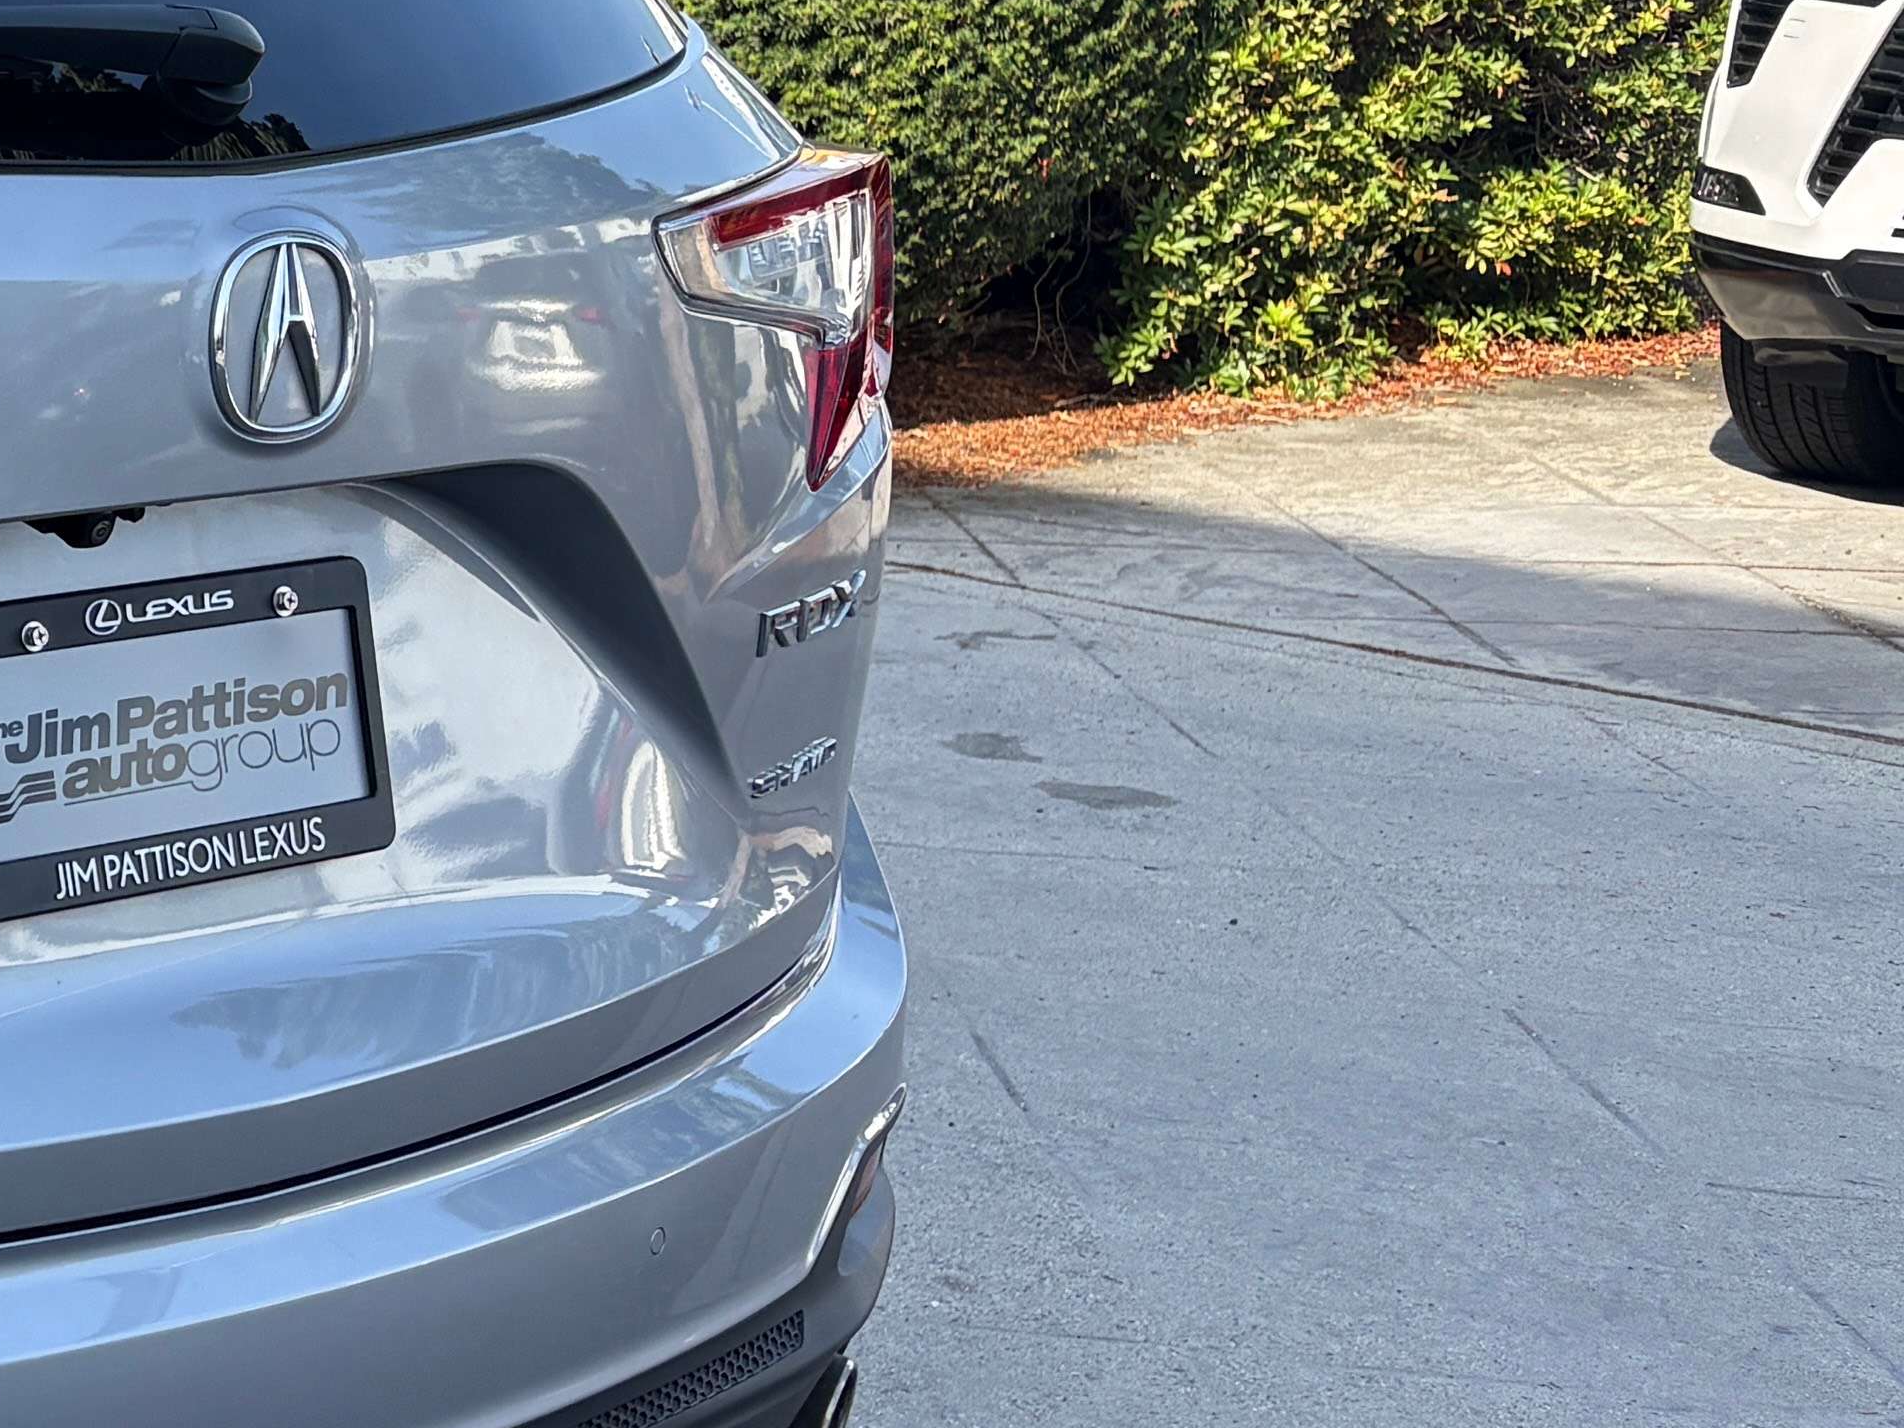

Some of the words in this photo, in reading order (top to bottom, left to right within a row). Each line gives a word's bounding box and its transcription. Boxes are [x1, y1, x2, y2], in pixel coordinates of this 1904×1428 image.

[125, 589, 234, 623] LEXUS
[755, 569, 867, 658] RDX
[5, 708, 111, 764] Jim
[116, 672, 348, 746] Pattison
[56, 857, 100, 900] JIM
[103, 832, 237, 891] PATTISON
[238, 816, 327, 865] LEXUS
